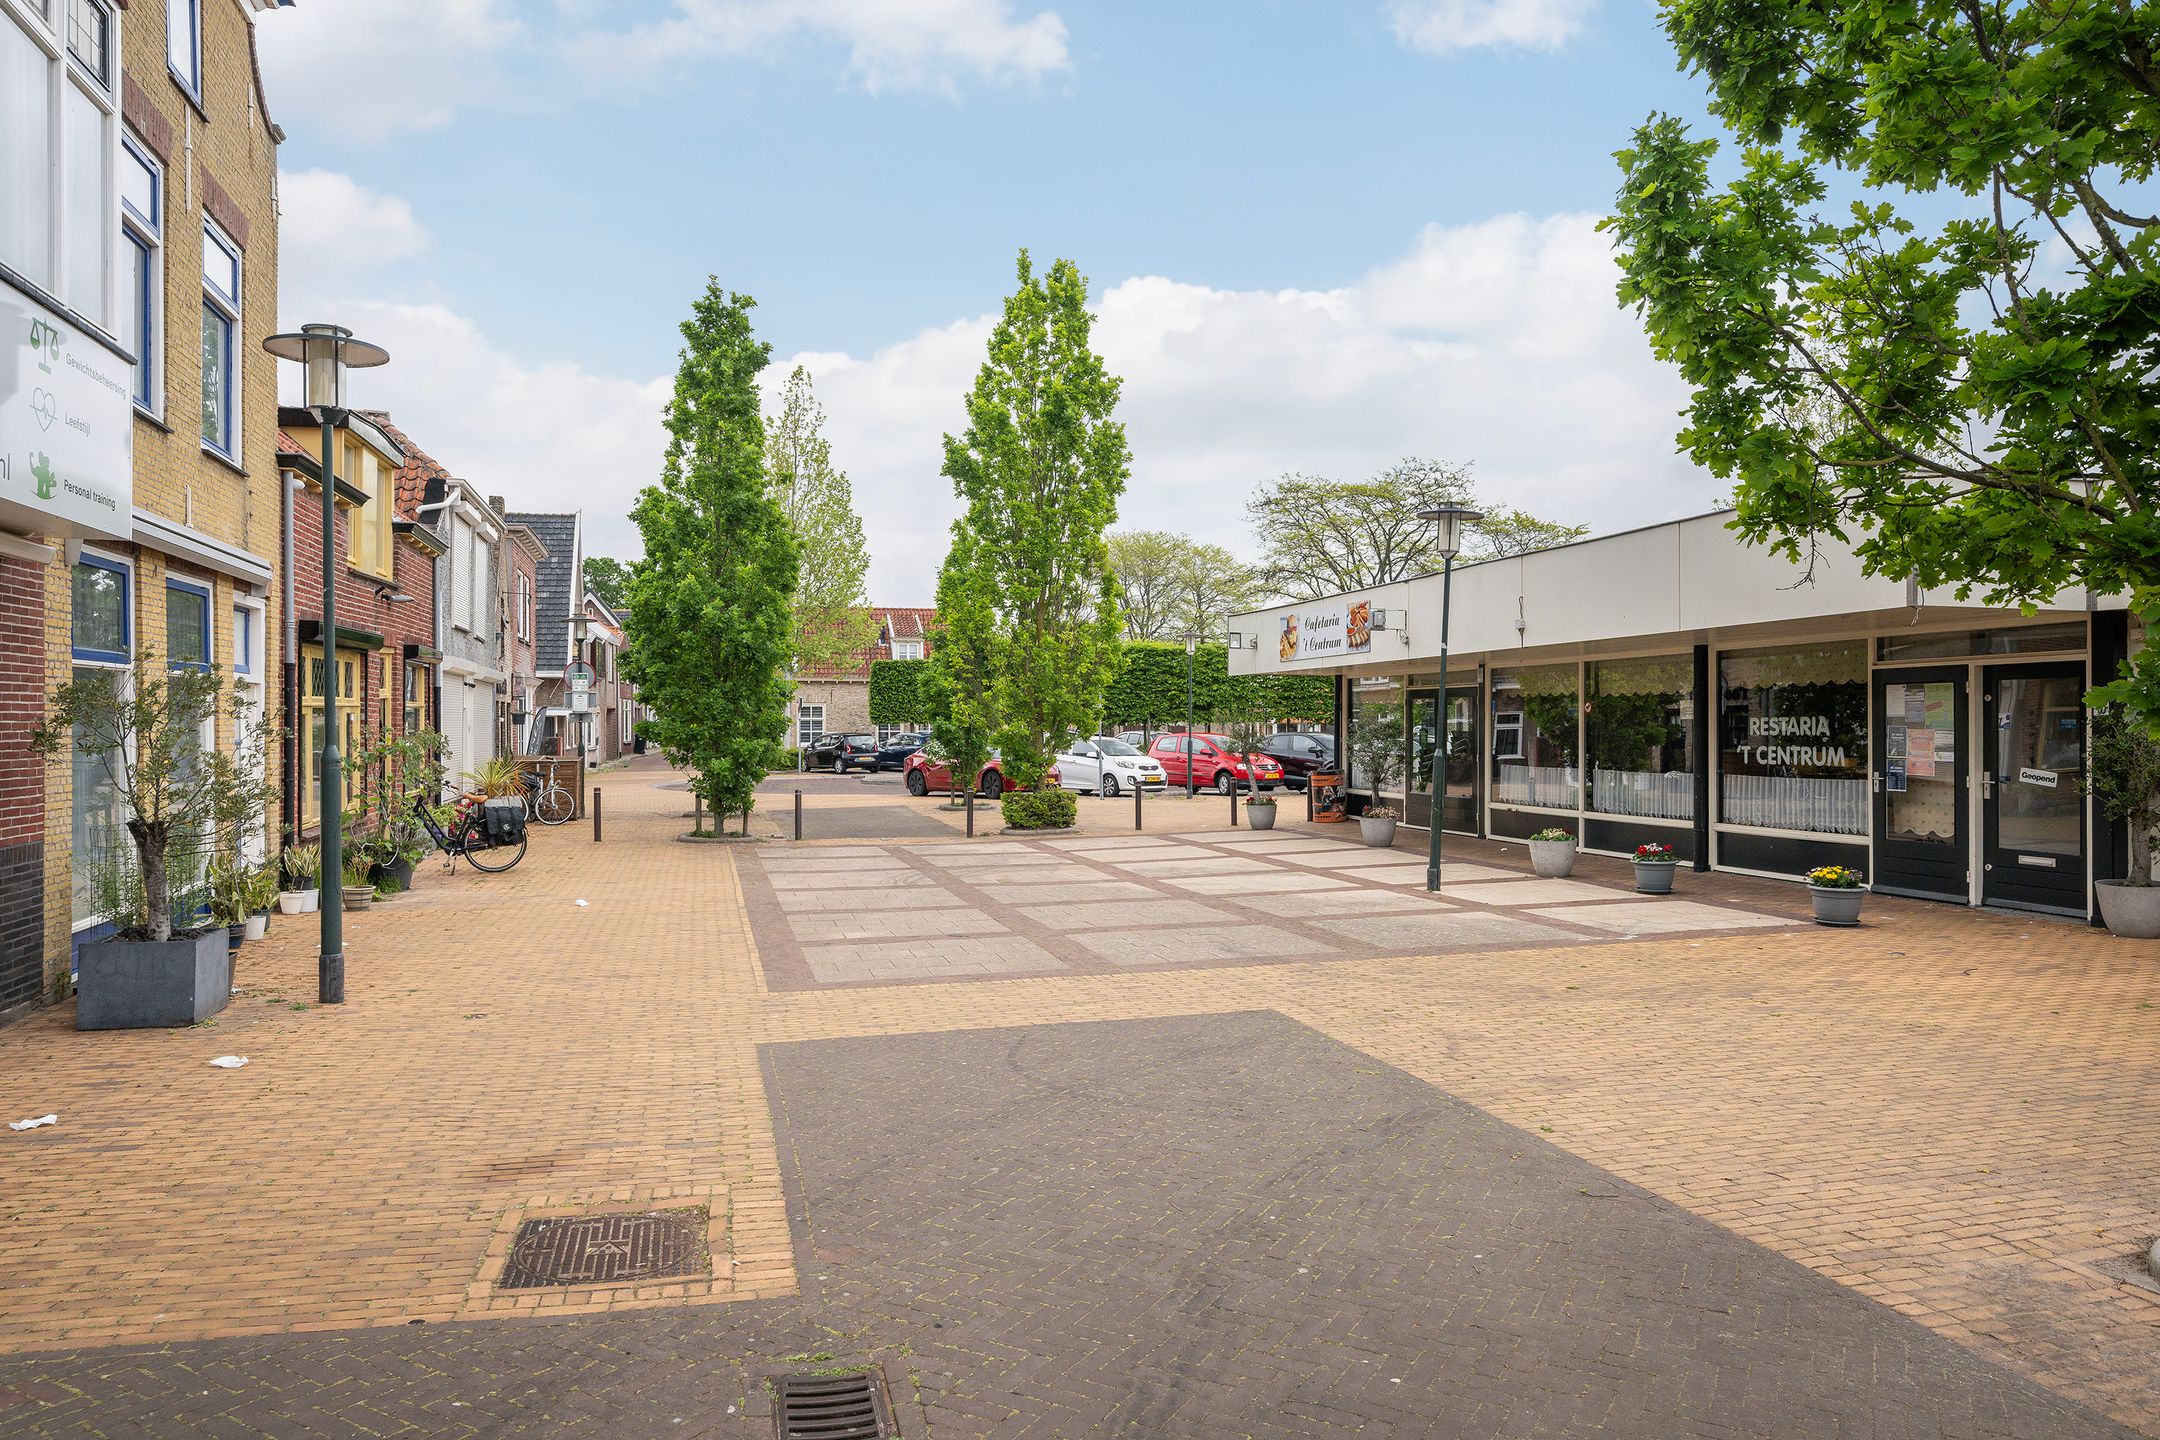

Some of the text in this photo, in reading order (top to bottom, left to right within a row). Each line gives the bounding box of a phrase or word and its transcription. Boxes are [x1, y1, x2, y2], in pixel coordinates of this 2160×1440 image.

[65, 352, 127, 401] Gewichtsbeheersing
[65, 412, 91, 437] Leefstijl
[63, 479, 116, 511] Personal training
[1304, 613, 1340, 632] Cafetaria
[1309, 636, 1342, 652] Centrum
[1749, 716, 1831, 737] RESTARIA
[1755, 745, 1846, 768] CENTRUM
[2021, 771, 2056, 784] Geopend
